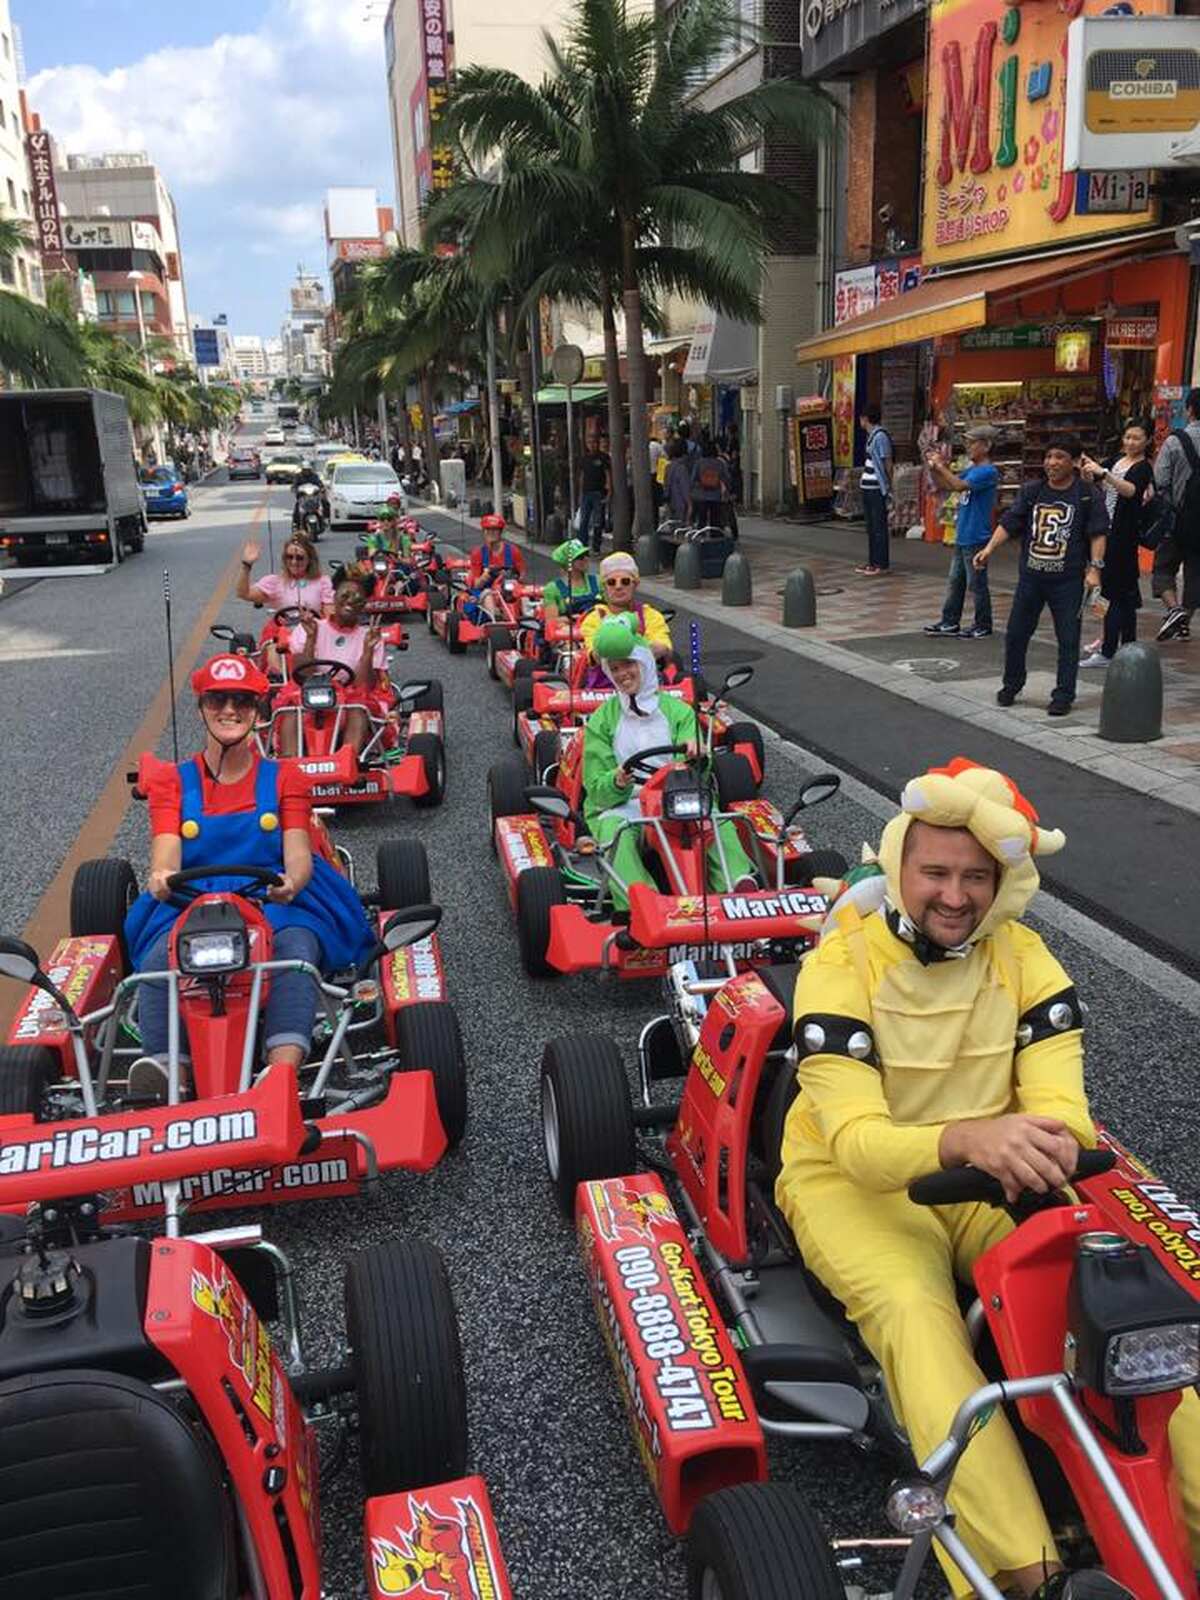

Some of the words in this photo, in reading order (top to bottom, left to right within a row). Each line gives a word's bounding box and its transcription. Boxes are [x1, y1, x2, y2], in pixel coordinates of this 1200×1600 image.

[1111, 83, 1175, 97] COHIBA
[34, 158, 60, 250] ホテル山の内
[1091, 172, 1146, 211] Mi-ja
[213, 661, 245, 680] M
[721, 892, 830, 920] MariCa
[132, 1158, 349, 1207] MriCar.com
[1111, 1187, 1154, 1222] Tour
[614, 1246, 715, 1431] 090-8888-4747
[657, 1241, 700, 1306] Go-Kart
[684, 1301, 722, 1365] Tokyo
[709, 1365, 748, 1421] Tour
